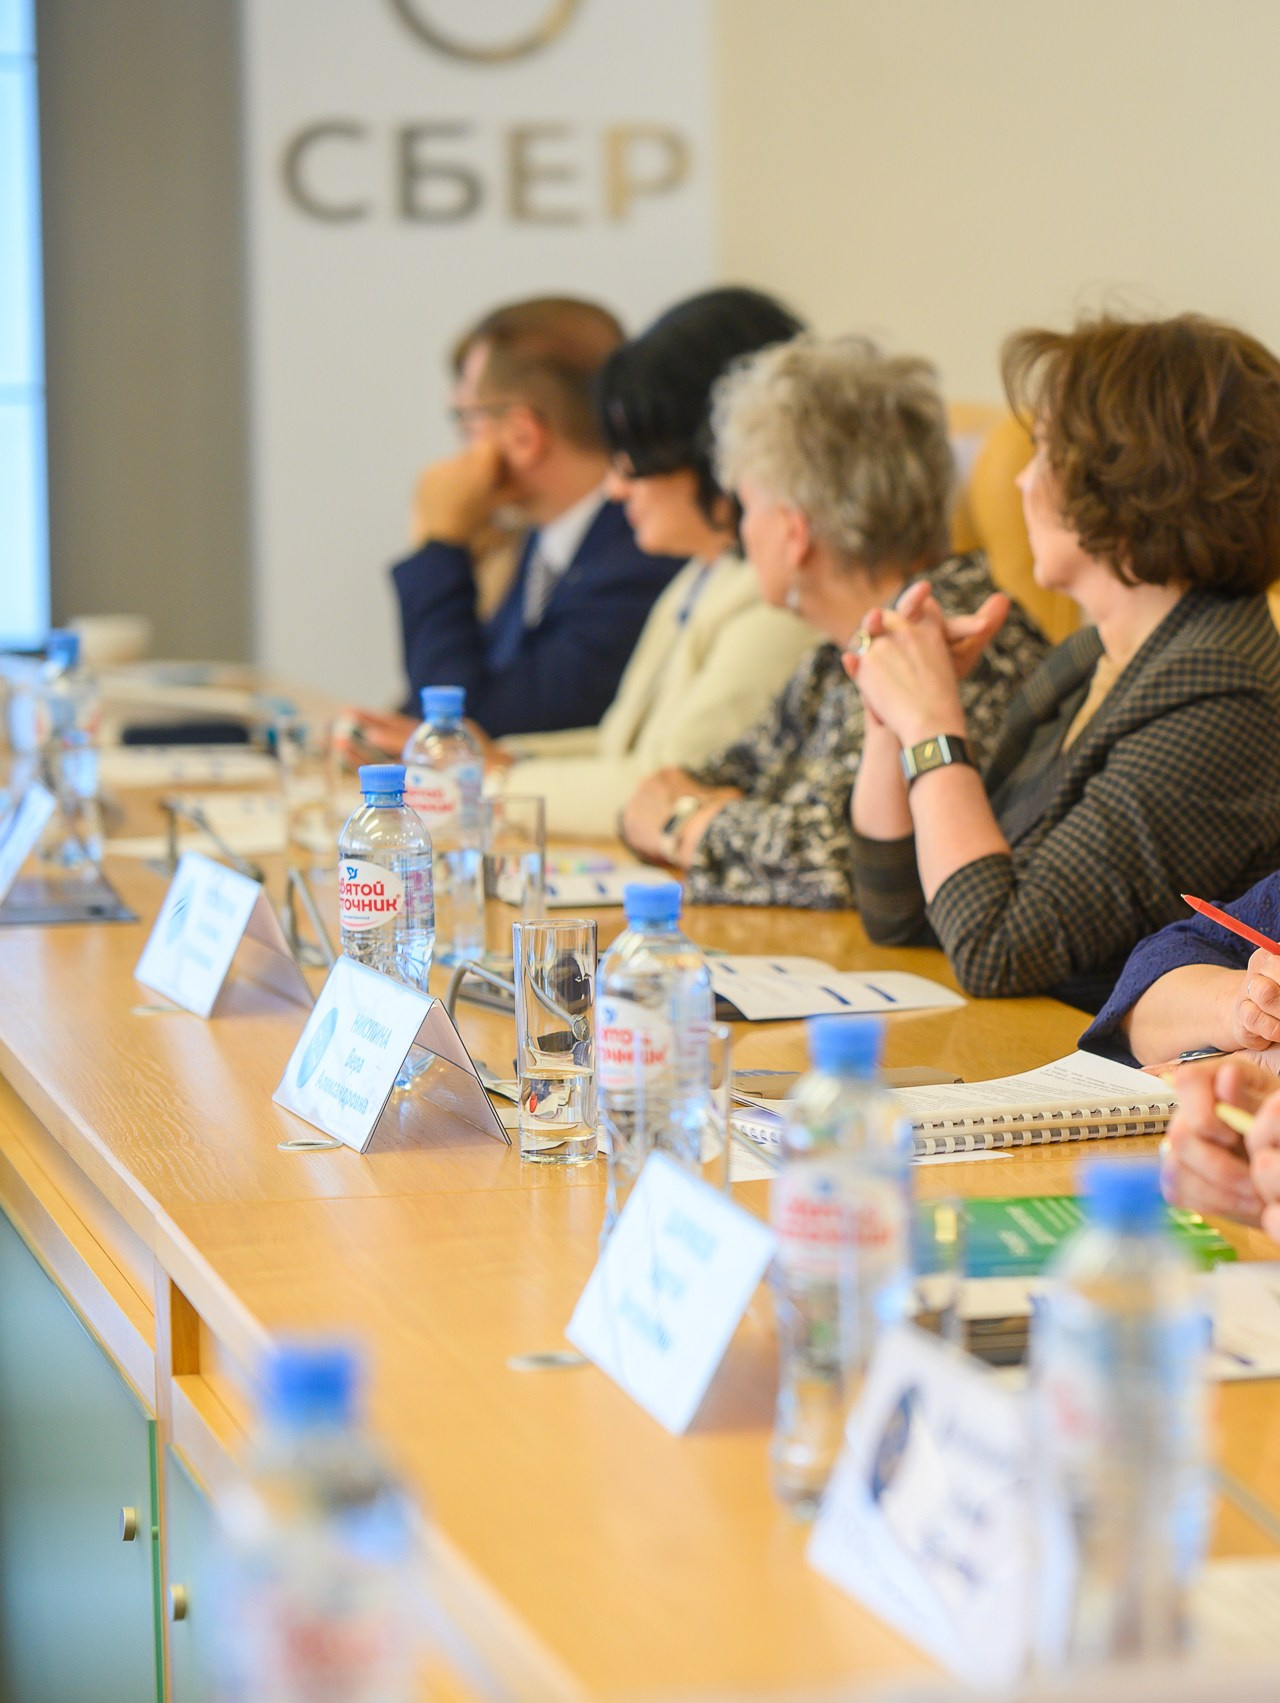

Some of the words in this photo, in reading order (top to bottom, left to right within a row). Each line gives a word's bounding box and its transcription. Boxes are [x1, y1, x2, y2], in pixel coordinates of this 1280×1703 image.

[279, 116, 692, 226] СБЕР
[340, 877, 384, 896] вятой
[340, 898, 398, 911] точник
[344, 1047, 365, 1076] Вера
[315, 1069, 369, 1115] Александровна
